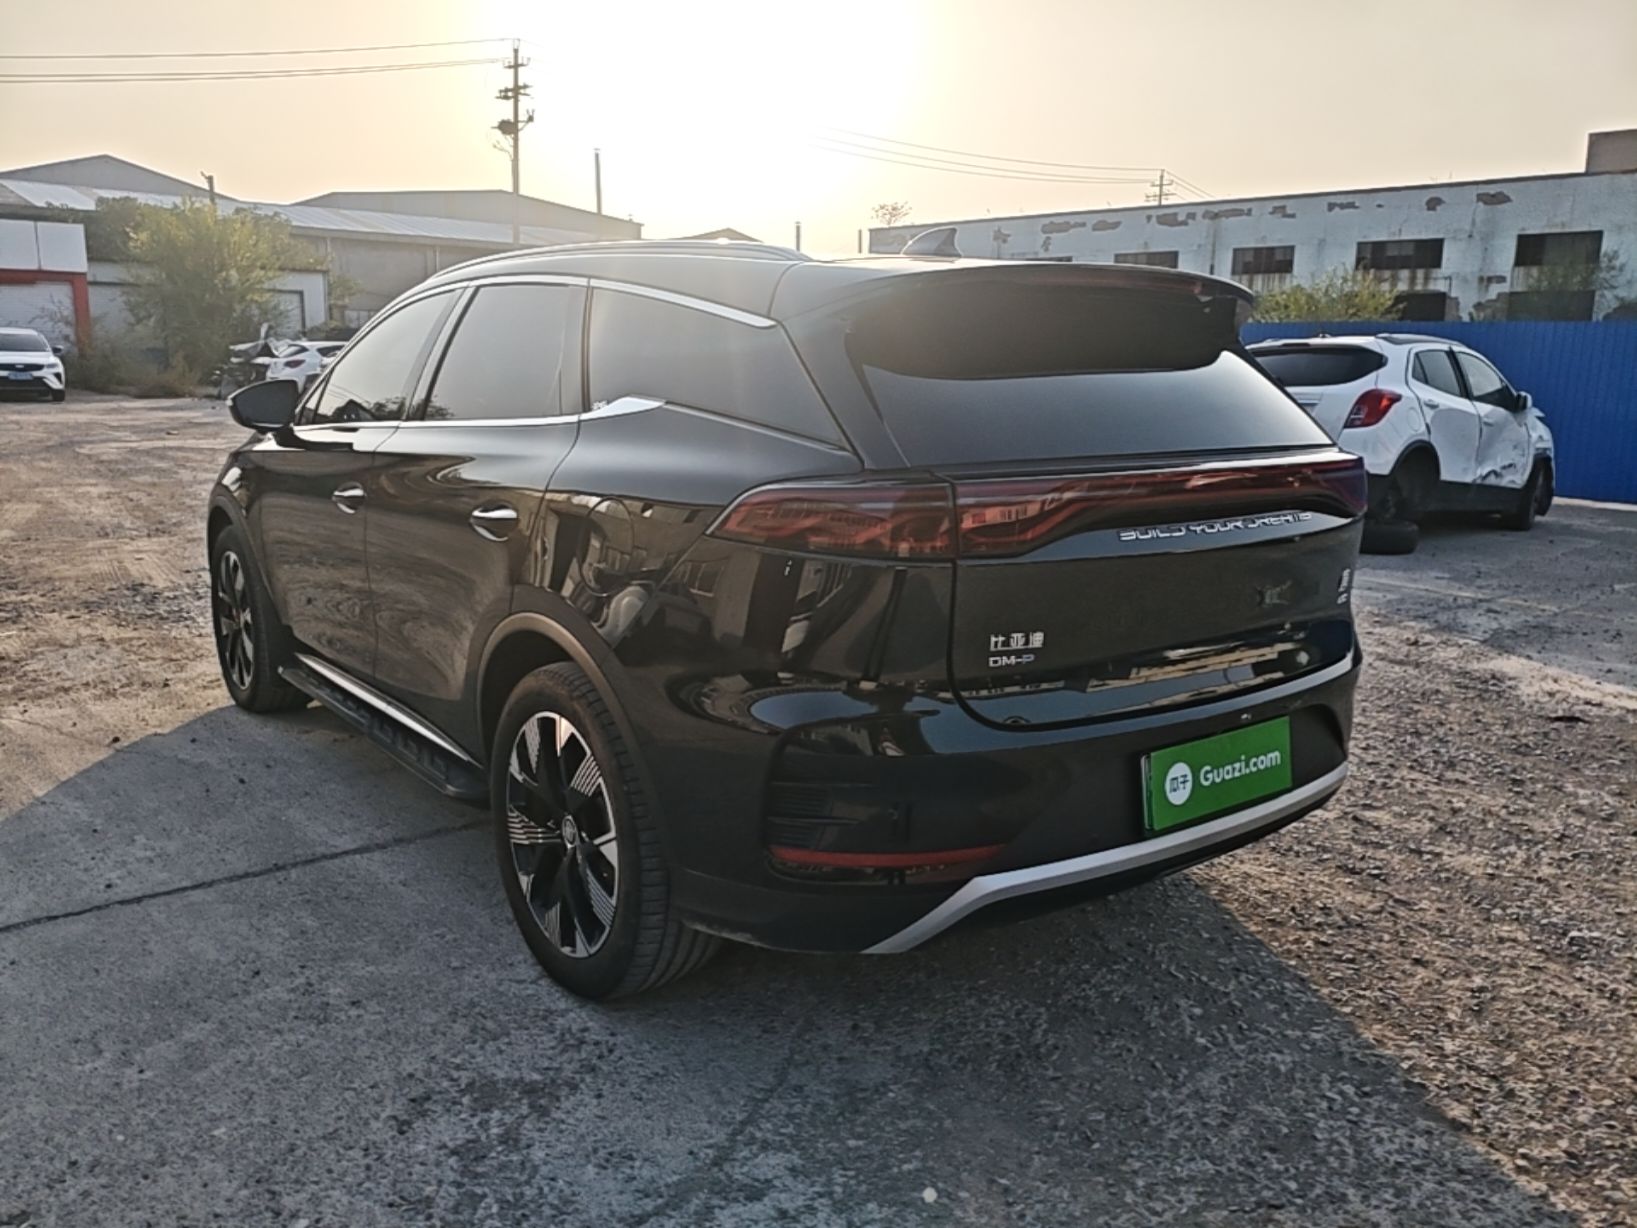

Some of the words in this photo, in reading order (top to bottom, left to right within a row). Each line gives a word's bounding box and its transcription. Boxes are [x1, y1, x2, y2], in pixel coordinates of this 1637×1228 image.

[1119, 527, 1186, 541] BUILD
[1188, 520, 1244, 534] YOUR
[989, 631, 1045, 651] 比亚迪
[1199, 750, 1282, 786] Guazi.com
[1169, 774, 1190, 793] 瓜子
